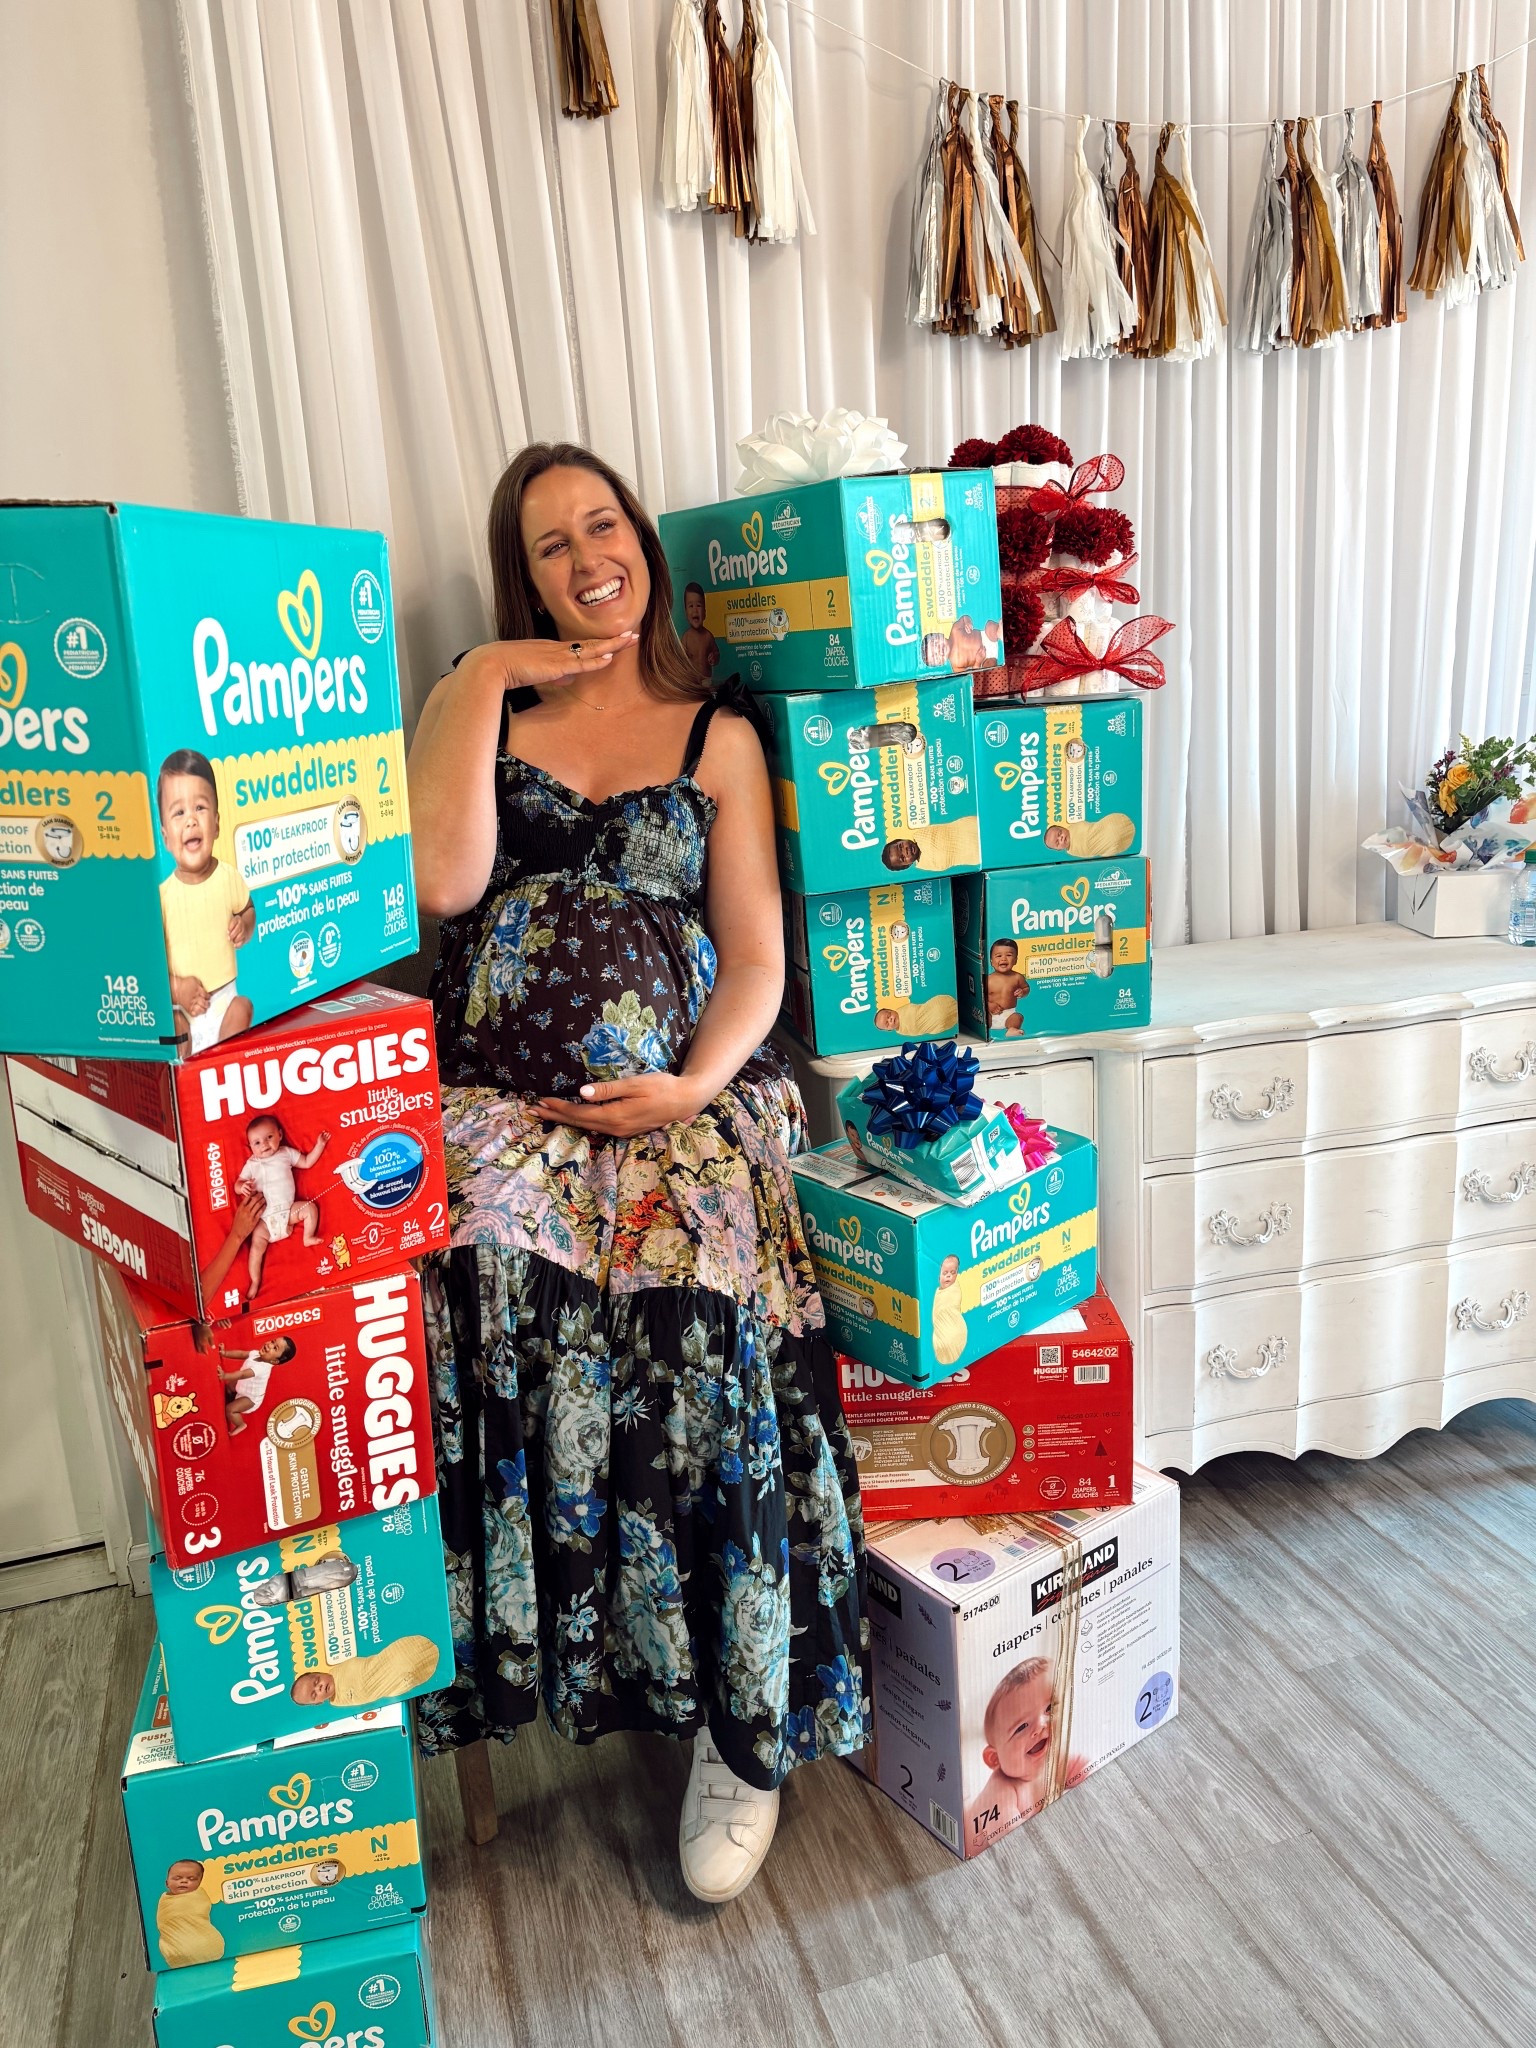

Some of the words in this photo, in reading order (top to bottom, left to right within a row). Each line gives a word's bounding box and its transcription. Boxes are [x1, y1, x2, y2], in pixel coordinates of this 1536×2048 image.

[965, 490, 974, 506] 84
[708, 539, 788, 586] Pampers
[727, 593, 776, 611] swaddlers
[826, 590, 835, 608] 2
[66, 626, 88, 650] #1
[829, 633, 840, 646] 84
[193, 617, 369, 737] Pampers
[933, 702, 943, 718] 96
[1054, 722, 1067, 736] N
[1107, 718, 1116, 732] 84
[236, 756, 357, 807] swaddlers
[376, 757, 390, 795] 2
[916, 761, 926, 806] protection
[1009, 731, 1045, 840] Pampers
[1051, 743, 1063, 822] swaddlers
[1076, 764, 1084, 805] protection
[95, 790, 116, 821] 2
[939, 780, 948, 815] protection
[918, 808, 926, 824] skin
[246, 826, 280, 853] 100%
[281, 818, 328, 840] LEAKPROOF
[244, 856, 269, 879] skin
[272, 841, 331, 875] protection
[1, 869, 26, 880] SANS
[28, 870, 60, 881] FUITES
[309, 878, 329, 896] SANS
[329, 871, 353, 889] FUITES
[28, 882, 45, 897] de
[382, 883, 405, 912] 148
[876, 893, 890, 906] N
[914, 888, 922, 901] 84
[257, 905, 311, 943] protection
[311, 899, 325, 918] de
[325, 895, 335, 911] la
[336, 890, 360, 914] peau
[1011, 898, 1117, 935] Pampers
[384, 918, 408, 937] COUCHES
[1119, 936, 1128, 951] 2
[840, 917, 872, 1014] Pampers
[876, 925, 890, 997] swaddlers
[901, 944, 909, 979] protection
[1030, 966, 1045, 975] skin
[1046, 963, 1085, 975] protection
[104, 974, 139, 994] 148
[1118, 988, 1131, 998] 84
[101, 994, 148, 1012] DIAPERS
[97, 1009, 156, 1027] COUCHES
[337, 1029, 354, 1039] douce
[199, 1027, 431, 1123] HUGGIES
[367, 1086, 399, 1105] little
[339, 1091, 434, 1129] snugglers
[374, 1151, 401, 1165] 100%
[866, 1131, 904, 1165] Pampers
[369, 1161, 392, 1173] blowout
[397, 1158, 408, 1166] leak
[375, 1166, 402, 1178] protection
[403, 1218, 420, 1234] 84
[427, 1202, 445, 1232] 2
[401, 1230, 424, 1244] DIAPERS
[970, 1201, 1050, 1259] Pampers
[80, 1213, 148, 1281] HUGGIES
[399, 1236, 426, 1251] COUCHES
[803, 1212, 884, 1275] Pampers
[982, 1241, 1041, 1279] swaddlers
[1062, 1227, 1071, 1246] N
[1062, 1263, 1073, 1275] 84
[815, 1261, 875, 1295] swaddlers
[892, 1296, 902, 1313] N
[995, 1277, 1025, 1298] protection
[1054, 1278, 1080, 1297] COUCHES
[987, 1303, 1012, 1322] protection
[893, 1339, 904, 1351] 84
[324, 1343, 350, 1401] little
[1033, 1367, 1068, 1375] HUGGIES
[352, 1274, 420, 1512] HUGGIES
[843, 1392, 873, 1403] little
[875, 1389, 935, 1402] snugglers
[876, 1410, 909, 1418] PROTECTION
[951, 1403, 972, 1411] CURVED
[267, 1445, 273, 1455] 12
[329, 1404, 358, 1511] snugglers
[288, 1452, 296, 1473] SKIN
[175, 1467, 187, 1496] COUCHES
[183, 1467, 194, 1492] DIAPERS
[195, 1469, 206, 1484] 76
[268, 1474, 273, 1482] of
[300, 1467, 310, 1499] GENTLE
[1078, 1477, 1092, 1486] 84
[1107, 1474, 1116, 1488] 1
[289, 1473, 302, 1520] PROTECTION
[1072, 1491, 1099, 1499] COUCHES
[271, 1493, 279, 1527] Protection
[382, 1514, 395, 1533] 84
[184, 1526, 222, 1555] 3
[292, 1534, 316, 1554] N
[364, 1555, 377, 1577] peau
[936, 1562, 971, 1582] 2
[367, 1577, 376, 1587] la
[367, 1588, 377, 1602] de
[992, 1622, 1043, 1659] diapers
[1109, 1556, 1153, 1594] pañales
[367, 1611, 383, 1644] protection
[340, 1637, 352, 1658] skin
[895, 1645, 941, 1687] pañales
[1139, 1691, 1152, 1723] 2
[140, 1733, 168, 1743] PUSH
[350, 1763, 365, 1777] #1
[900, 1764, 915, 1800] 2
[197, 1799, 354, 1852] Pampers
[973, 1804, 1000, 1835] 174
[224, 1842, 339, 1875] swaddlers
[370, 1834, 388, 1854] N
[228, 1889, 250, 1900] skin
[252, 1877, 308, 1898] protection
[231, 1876, 260, 1890] 100%
[261, 1869, 306, 1884] LEAKPROOF
[375, 1883, 394, 1895] 84
[254, 1896, 284, 1908] 100%
[284, 1893, 304, 1902] SANS
[304, 1888, 329, 1900] FUITES
[367, 1896, 404, 1911] COUCHES
[238, 1906, 286, 1923] protection
[287, 1902, 299, 1910] de
[300, 1900, 310, 1908] la
[311, 1895, 336, 1908] peau
[368, 1979, 386, 1994] #1
